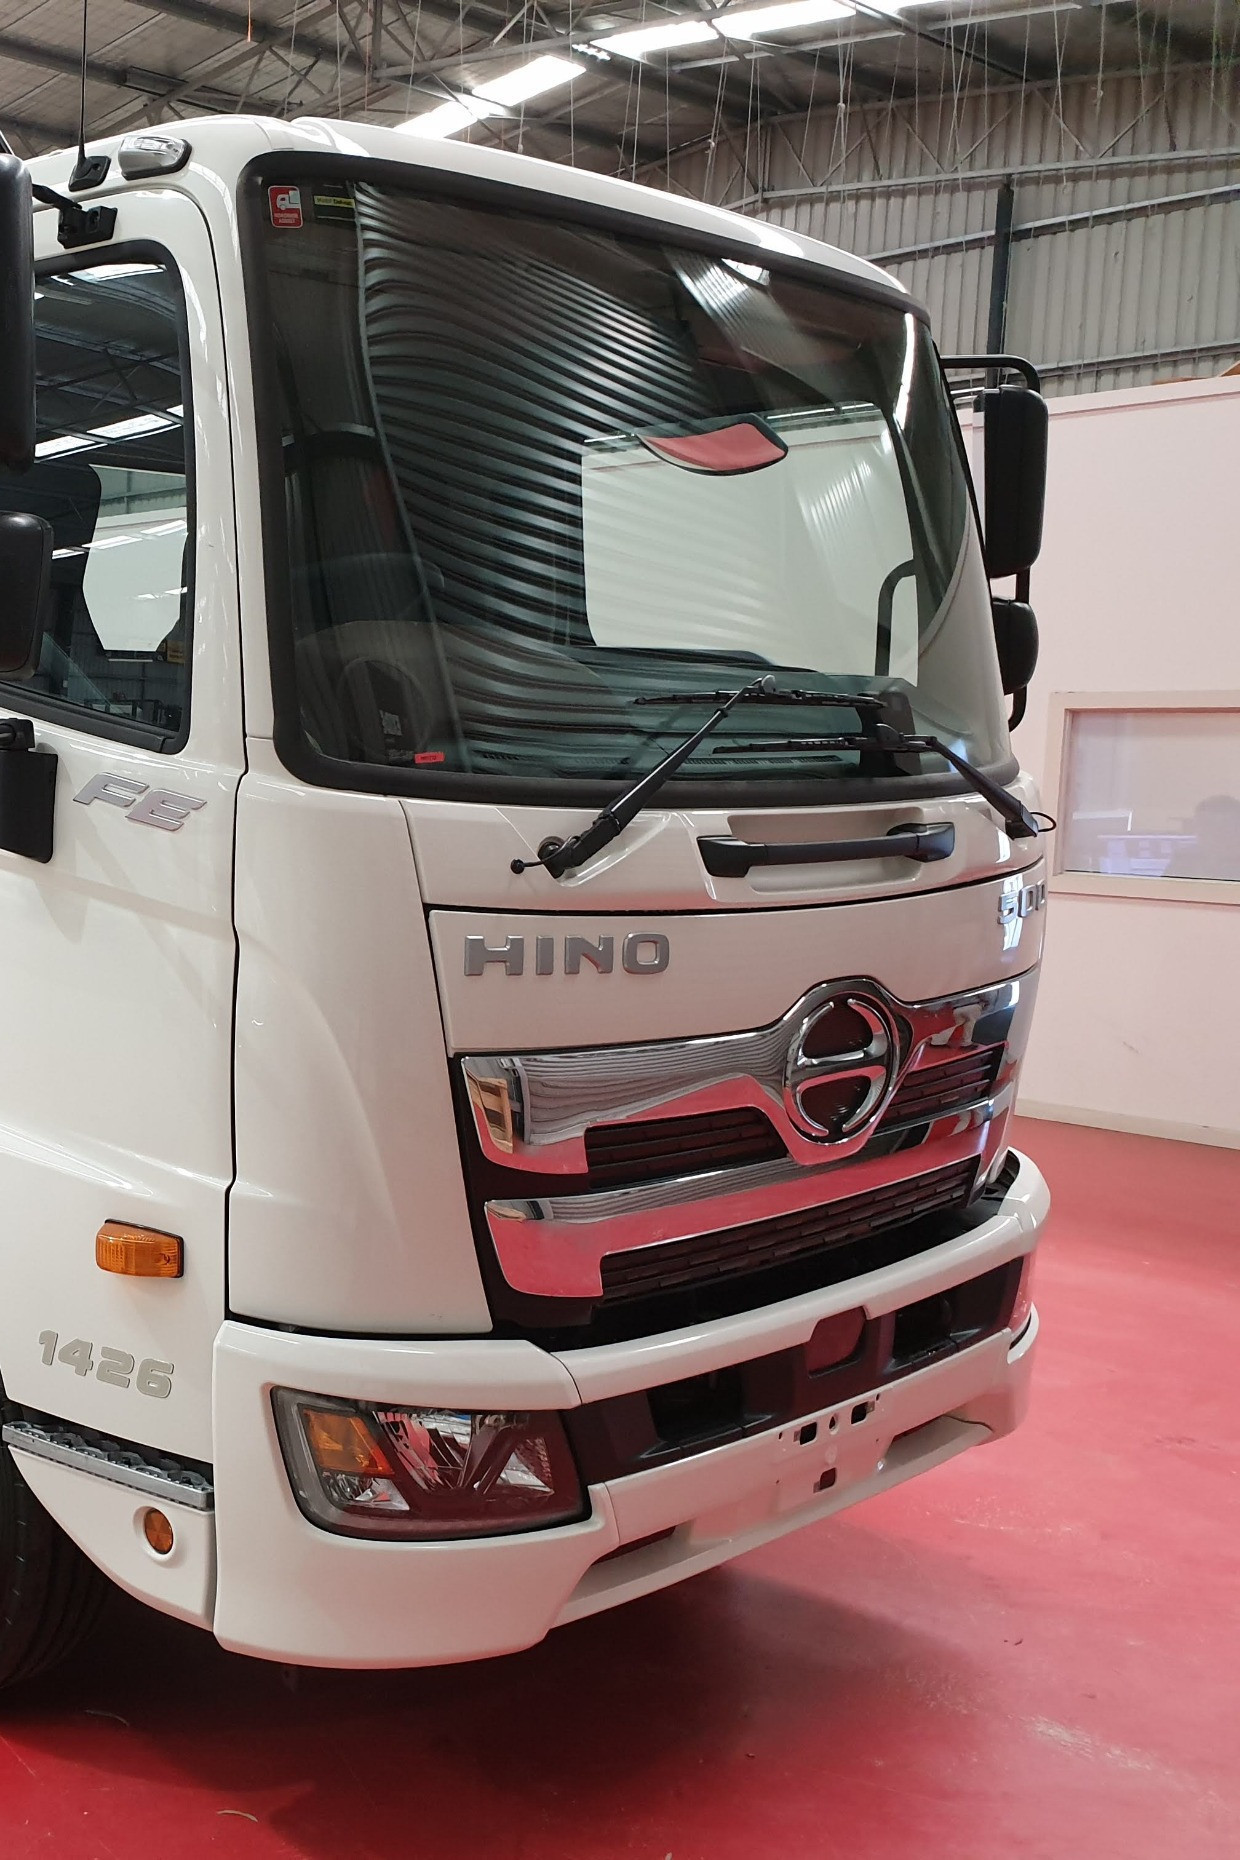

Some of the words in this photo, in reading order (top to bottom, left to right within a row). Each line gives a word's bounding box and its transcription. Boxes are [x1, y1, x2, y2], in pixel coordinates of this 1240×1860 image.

[72, 772, 207, 831] FE
[464, 932, 670, 976] HINO
[38, 1329, 175, 1399] 1426
